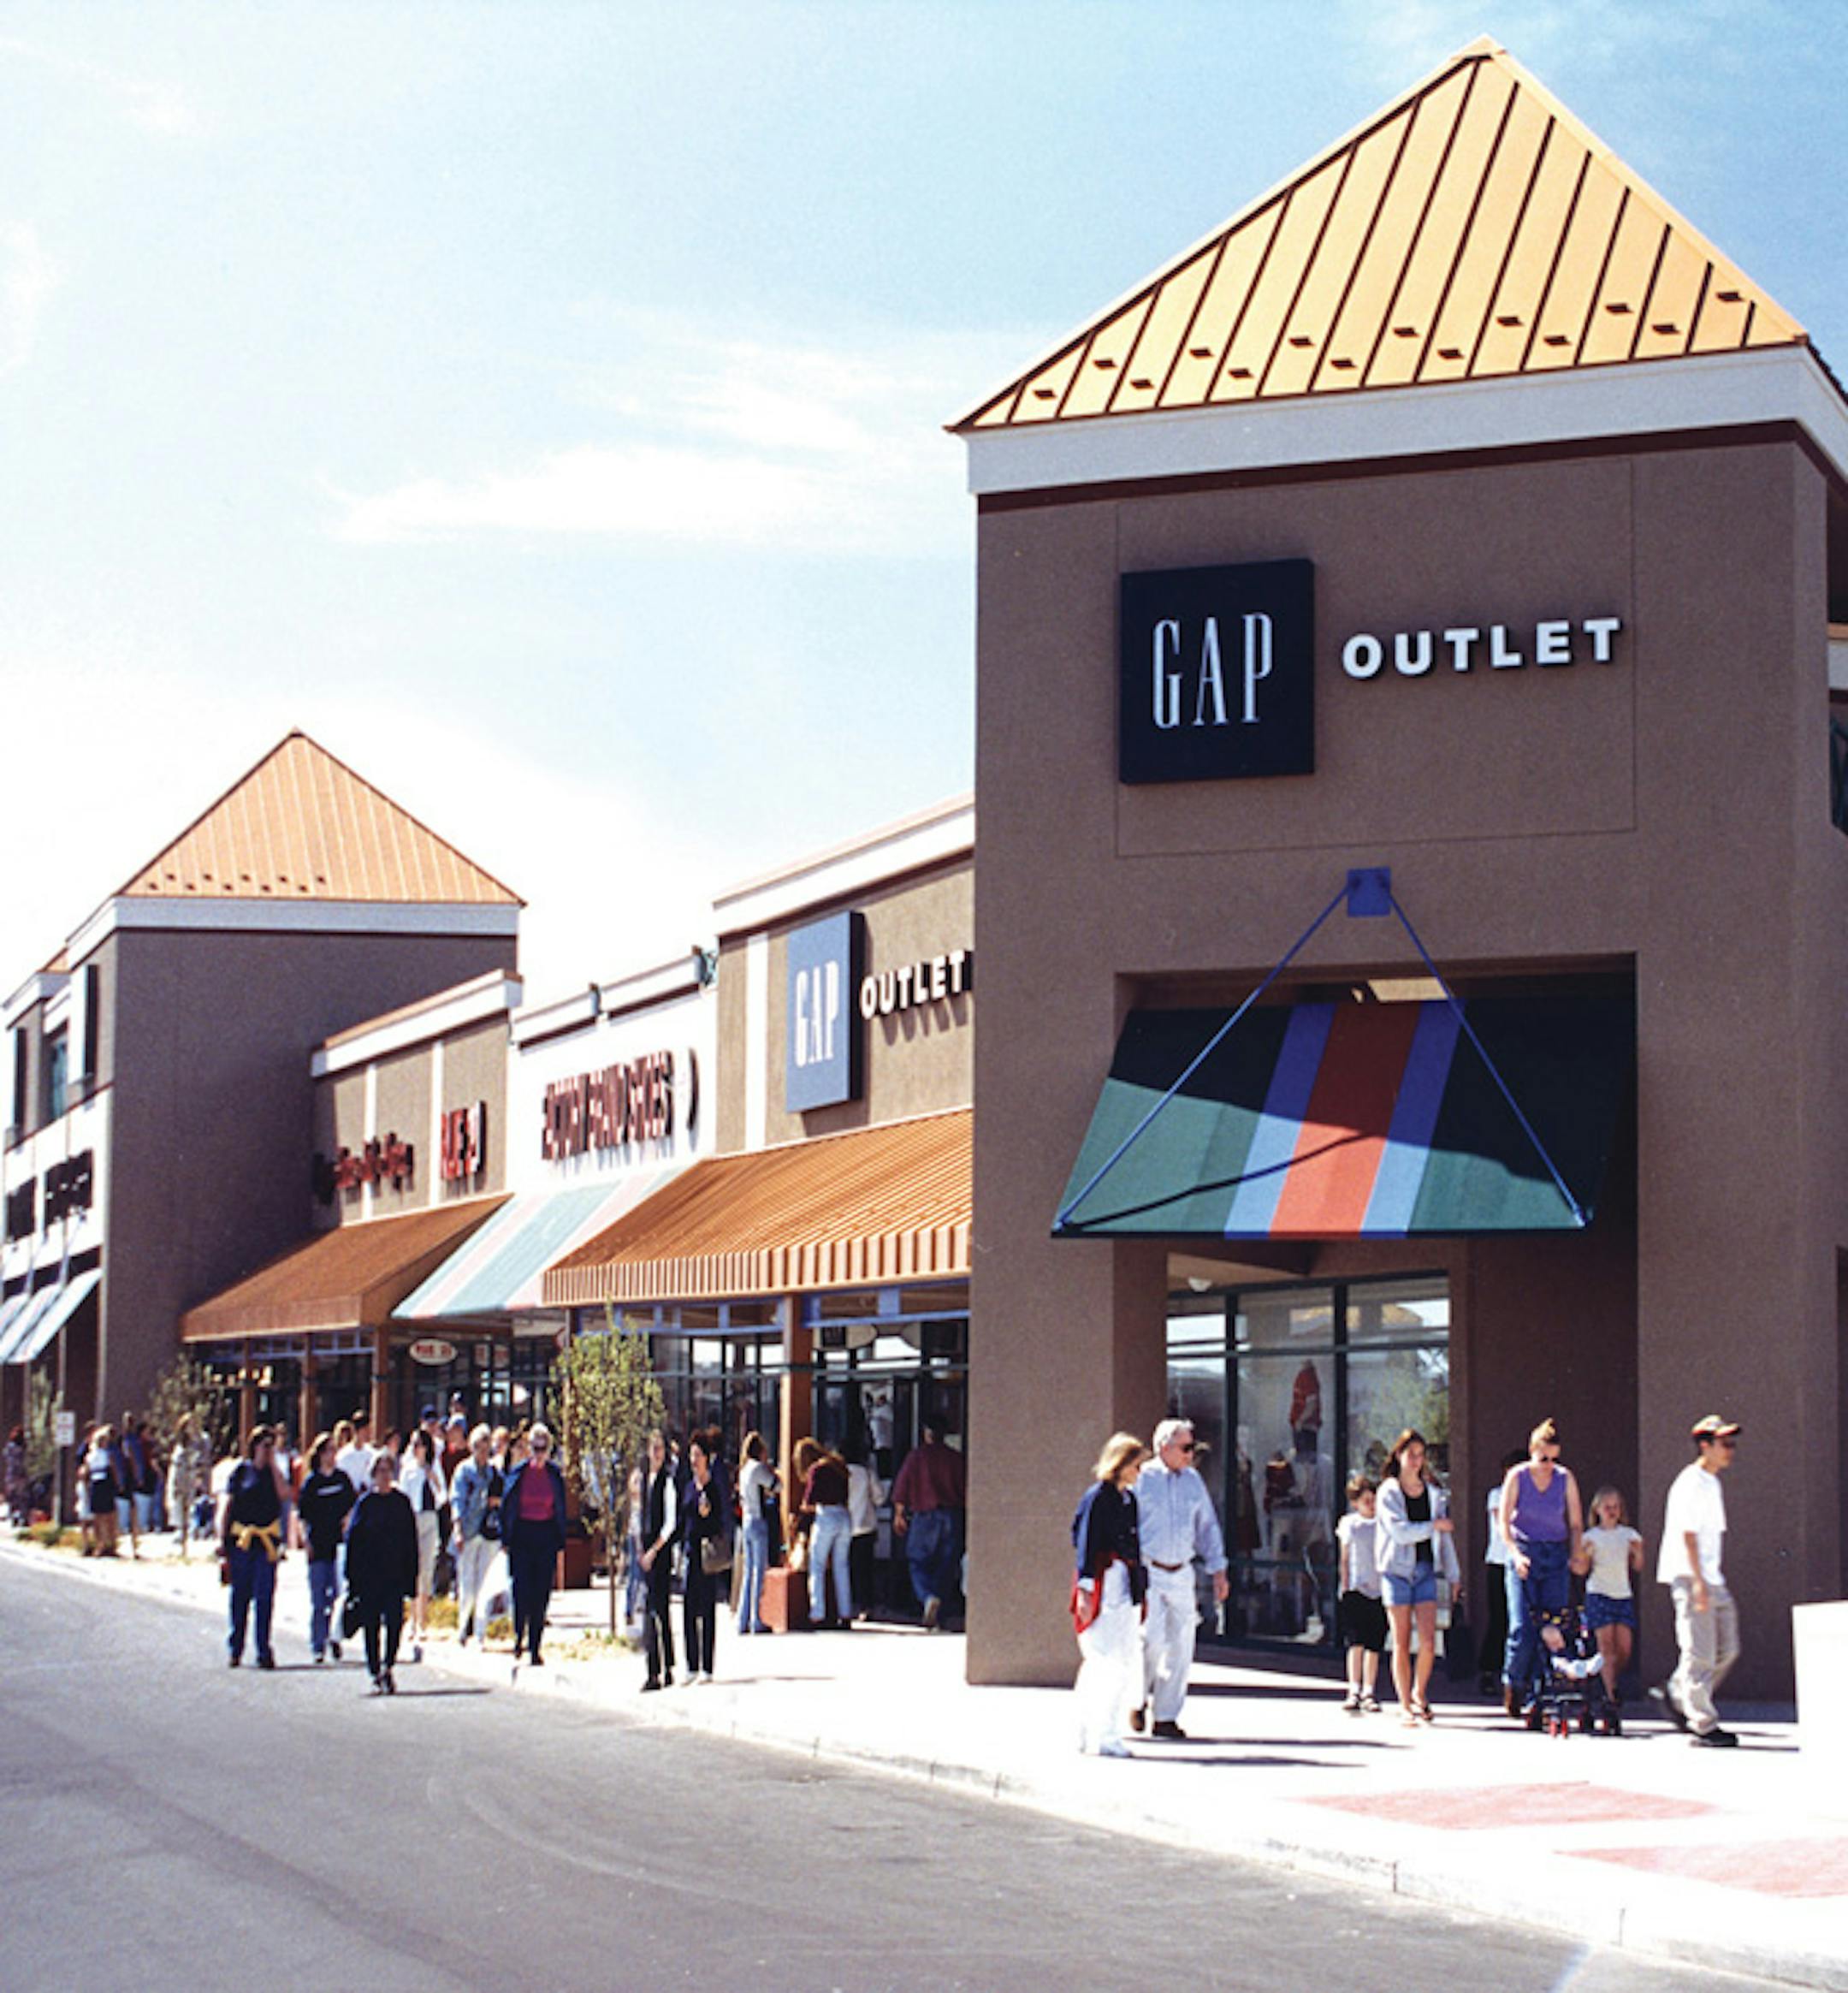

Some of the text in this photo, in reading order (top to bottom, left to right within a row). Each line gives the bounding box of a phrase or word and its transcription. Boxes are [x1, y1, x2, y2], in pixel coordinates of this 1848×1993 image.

[1152, 611, 1621, 729] GAP OUTLET
[794, 948, 968, 1067] GAP OUTLET
